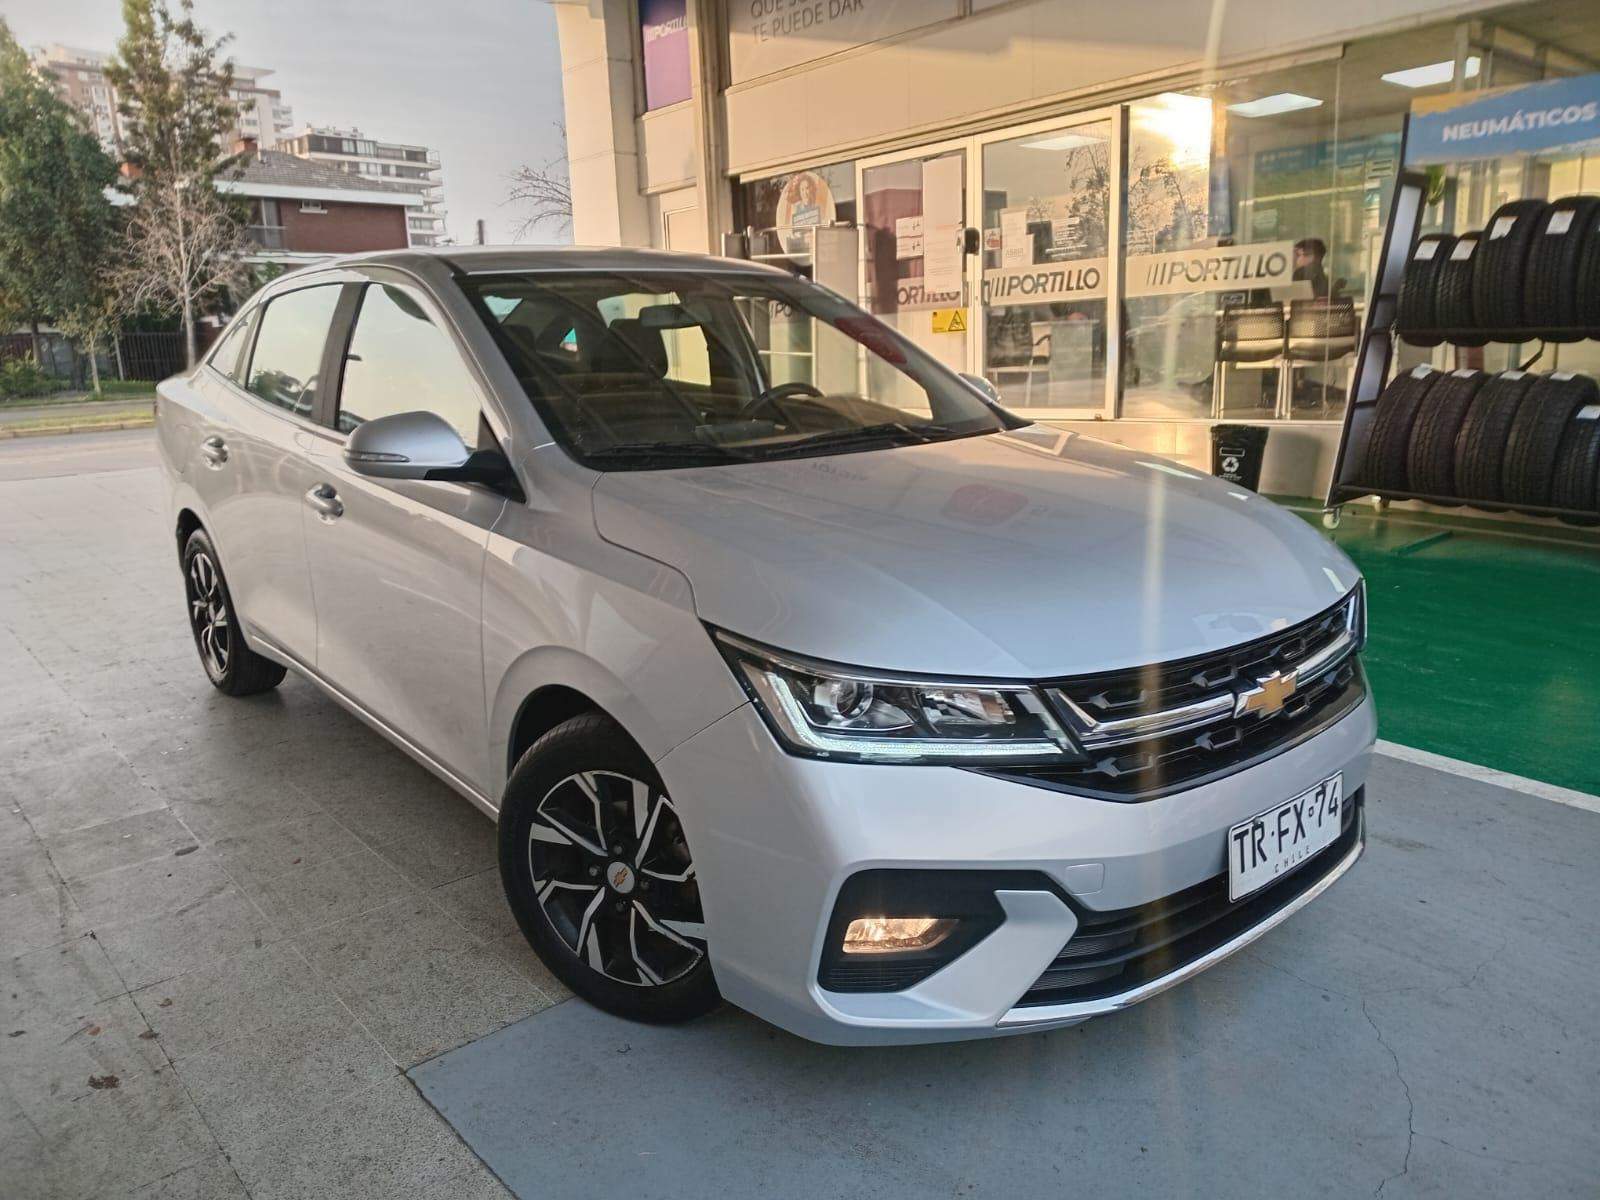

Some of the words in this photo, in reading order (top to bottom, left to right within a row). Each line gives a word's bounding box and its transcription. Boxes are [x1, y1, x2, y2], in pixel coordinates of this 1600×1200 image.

[772, 3, 823, 38] PUEDE
[1441, 102, 1598, 143] NEUMÁTICOS
[1006, 267, 1101, 297] PORTILLO
[1166, 251, 1287, 286] PORTILLO
[1274, 846, 1310, 873] CHILE
